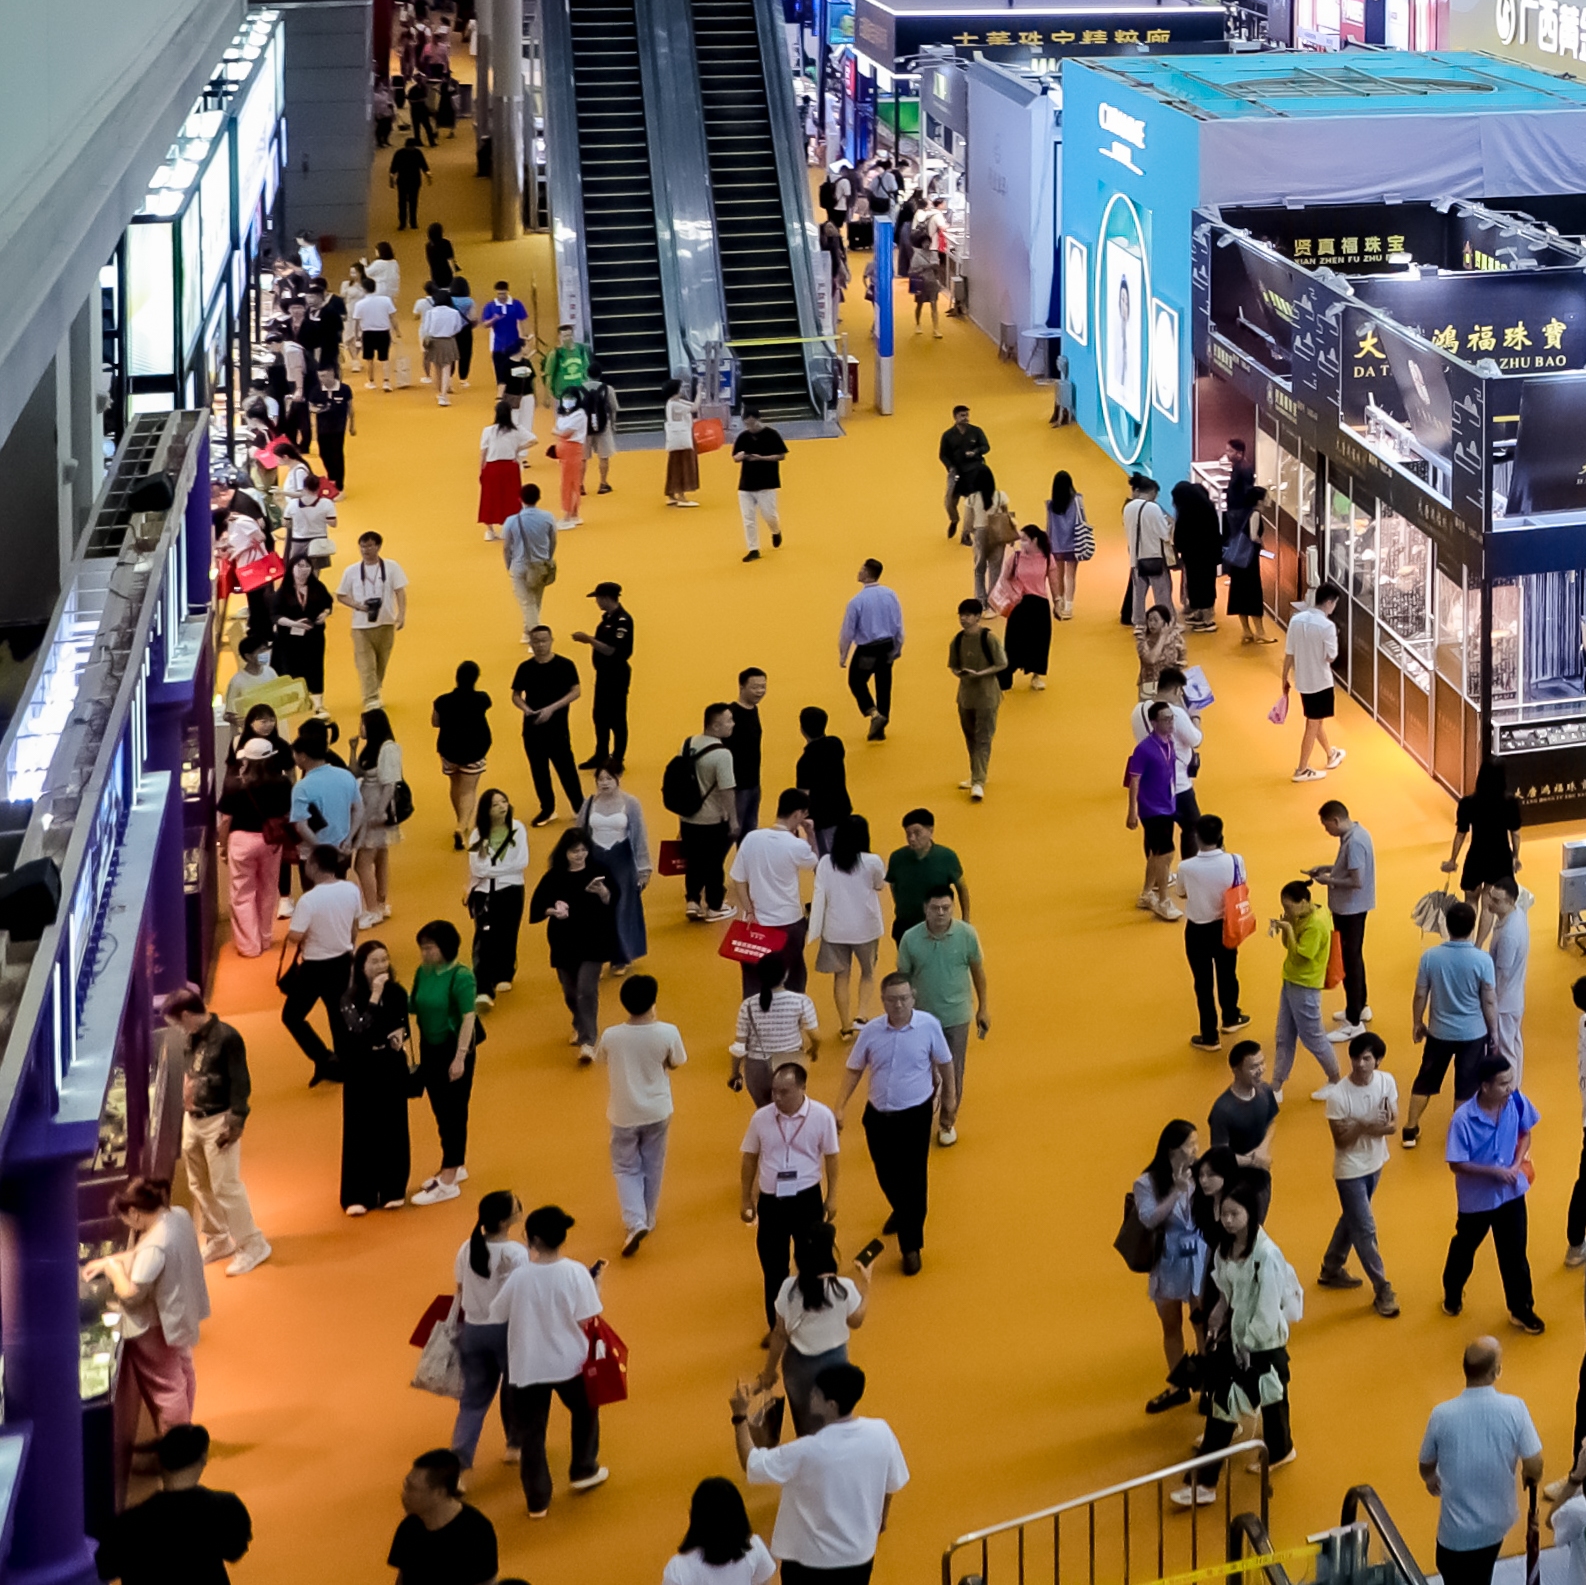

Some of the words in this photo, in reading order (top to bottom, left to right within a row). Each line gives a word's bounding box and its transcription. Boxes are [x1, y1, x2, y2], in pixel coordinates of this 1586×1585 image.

[1319, 256, 1345, 264] ZHEN
[1347, 255, 1360, 263] FU
[1363, 254, 1383, 262] ZHU
[1354, 318, 1567, 359] 大鴻福珠寶
[1353, 367, 1376, 378] DA
[1500, 356, 1531, 369] ZHU
[1535, 354, 1567, 368] BAO
